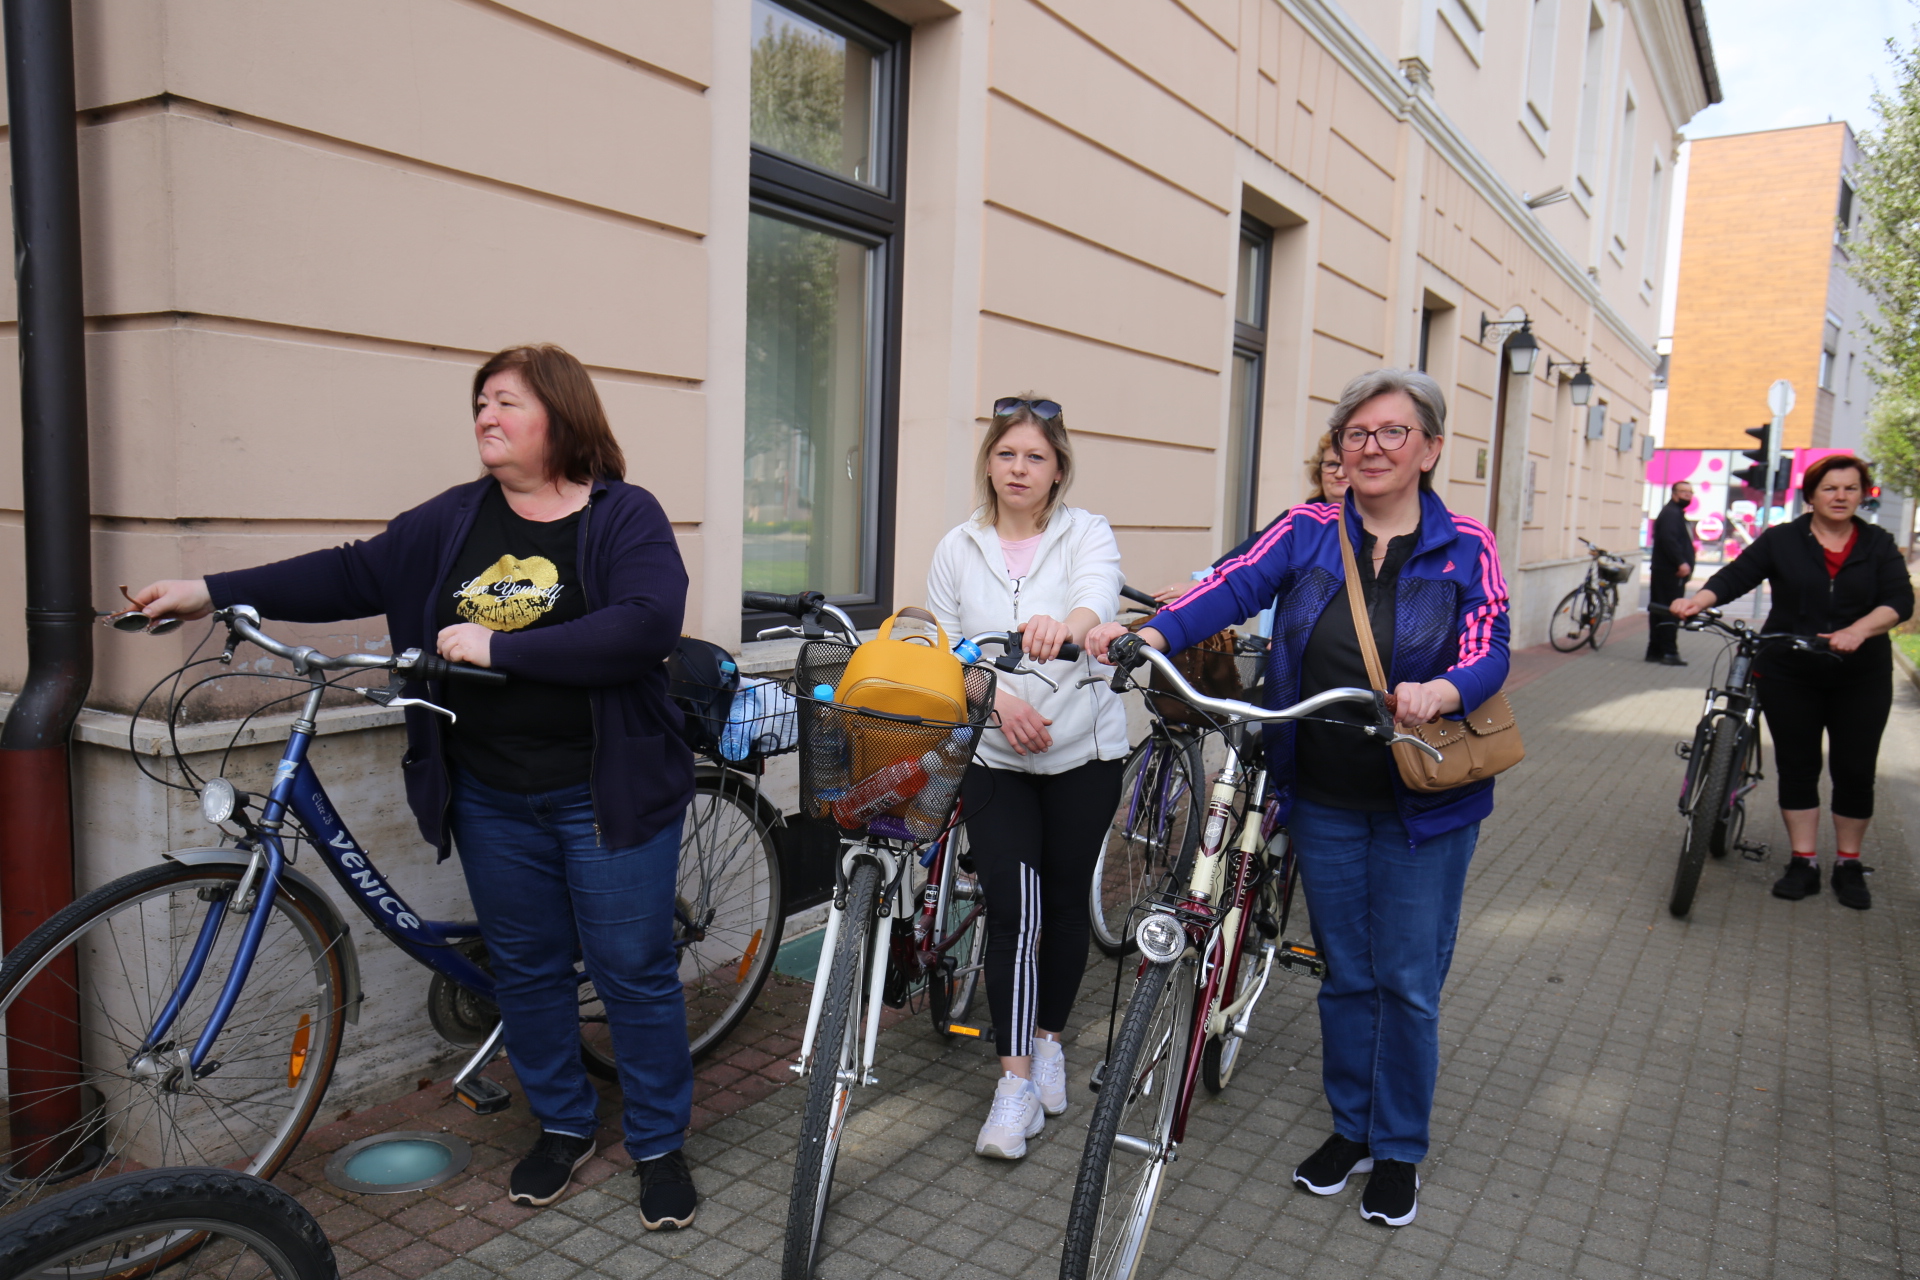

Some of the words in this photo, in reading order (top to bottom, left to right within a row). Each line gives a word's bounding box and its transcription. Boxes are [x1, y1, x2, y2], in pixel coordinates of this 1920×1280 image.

[453, 576, 490, 600] Love
[494, 575, 564, 606] Yourself
[329, 829, 420, 930] VENICE
